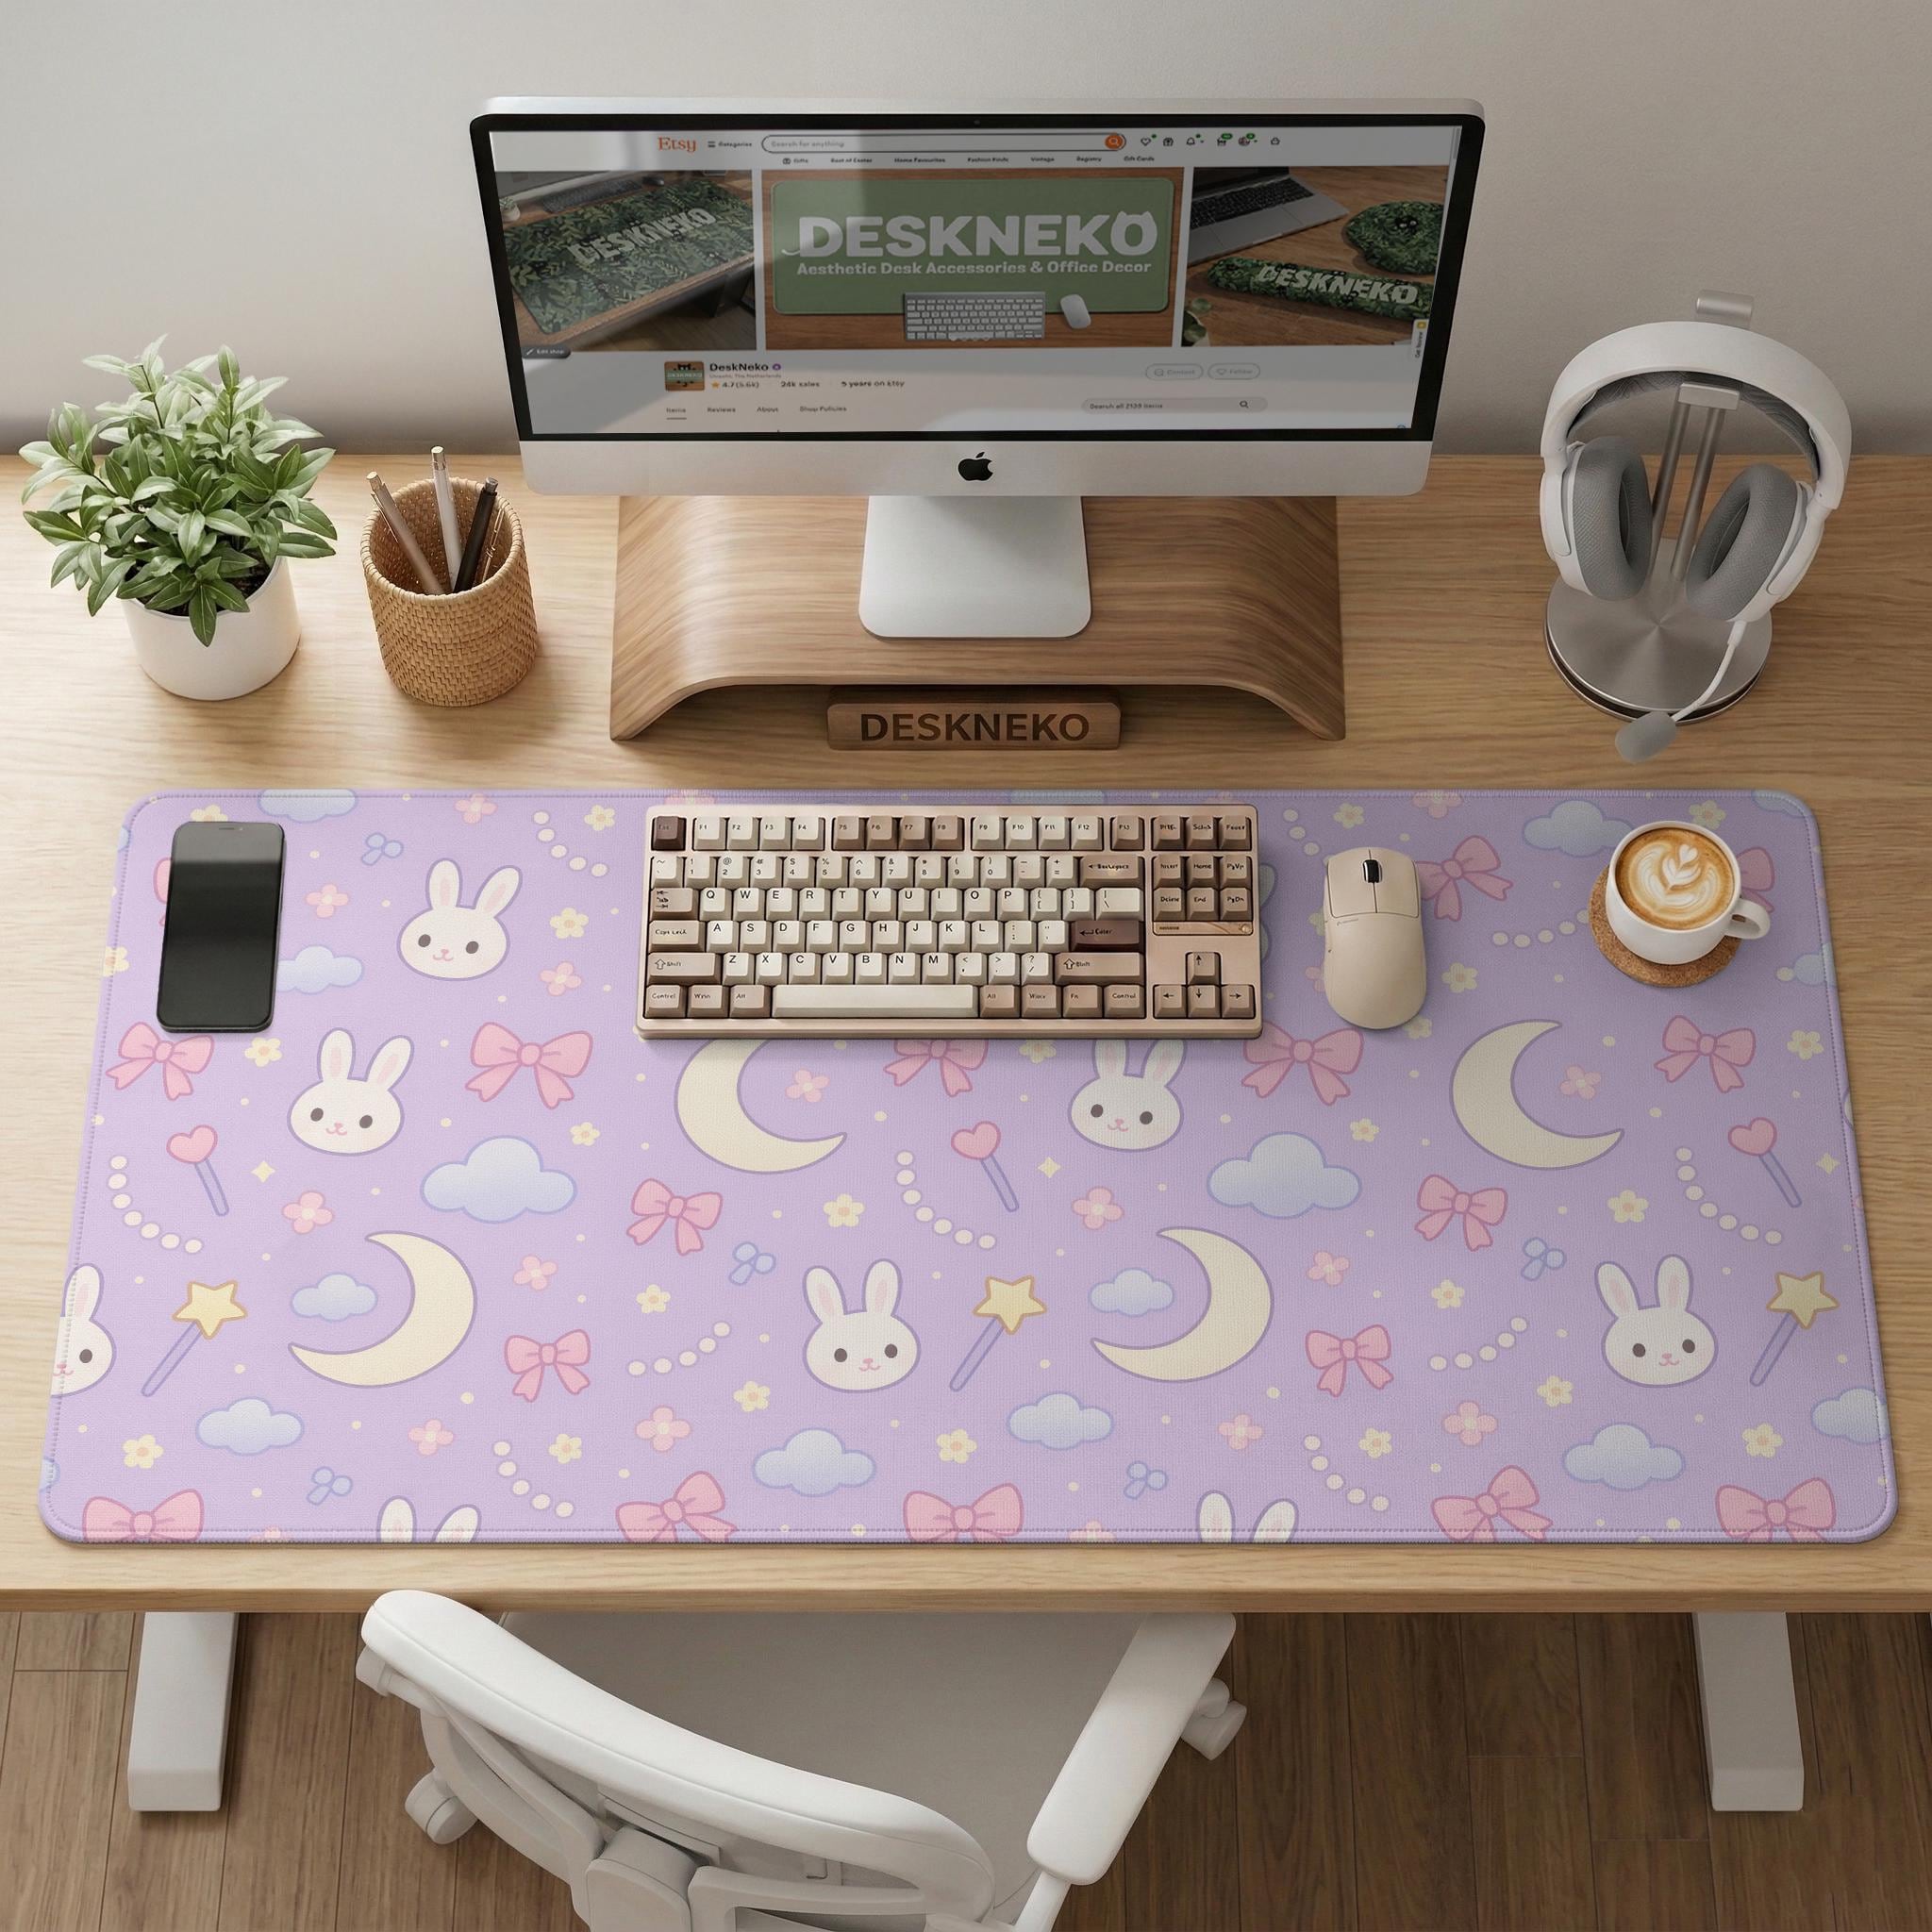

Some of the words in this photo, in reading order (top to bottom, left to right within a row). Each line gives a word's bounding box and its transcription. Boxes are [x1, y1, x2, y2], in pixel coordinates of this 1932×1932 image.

[658, 136, 697, 152] Etsy
[811, 141, 844, 149] anything
[566, 208, 717, 265] DESKNEKO
[798, 211, 1158, 258] DESKNEKO
[797, 261, 877, 275] Aesthetic
[880, 261, 923, 275] Desk
[925, 261, 1026, 275] Accessories
[1030, 261, 1042, 274] &
[1046, 260, 1099, 274] Office
[1102, 260, 1152, 274] Decor
[1254, 264, 1418, 304] DESKNEKO
[709, 363, 769, 372] DeskNeko
[887, 380, 906, 389] Etsy
[860, 713, 1091, 741] DESKNEKO
[773, 891, 779, 899] E
[906, 891, 912, 899] U
[937, 891, 941, 899] I
[971, 891, 979, 899] O
[1005, 891, 1011, 899] P
[747, 924, 754, 932] S
[780, 923, 787, 931] D
[812, 923, 820, 931] F
[946, 924, 952, 932] K
[796, 955, 804, 963] C
